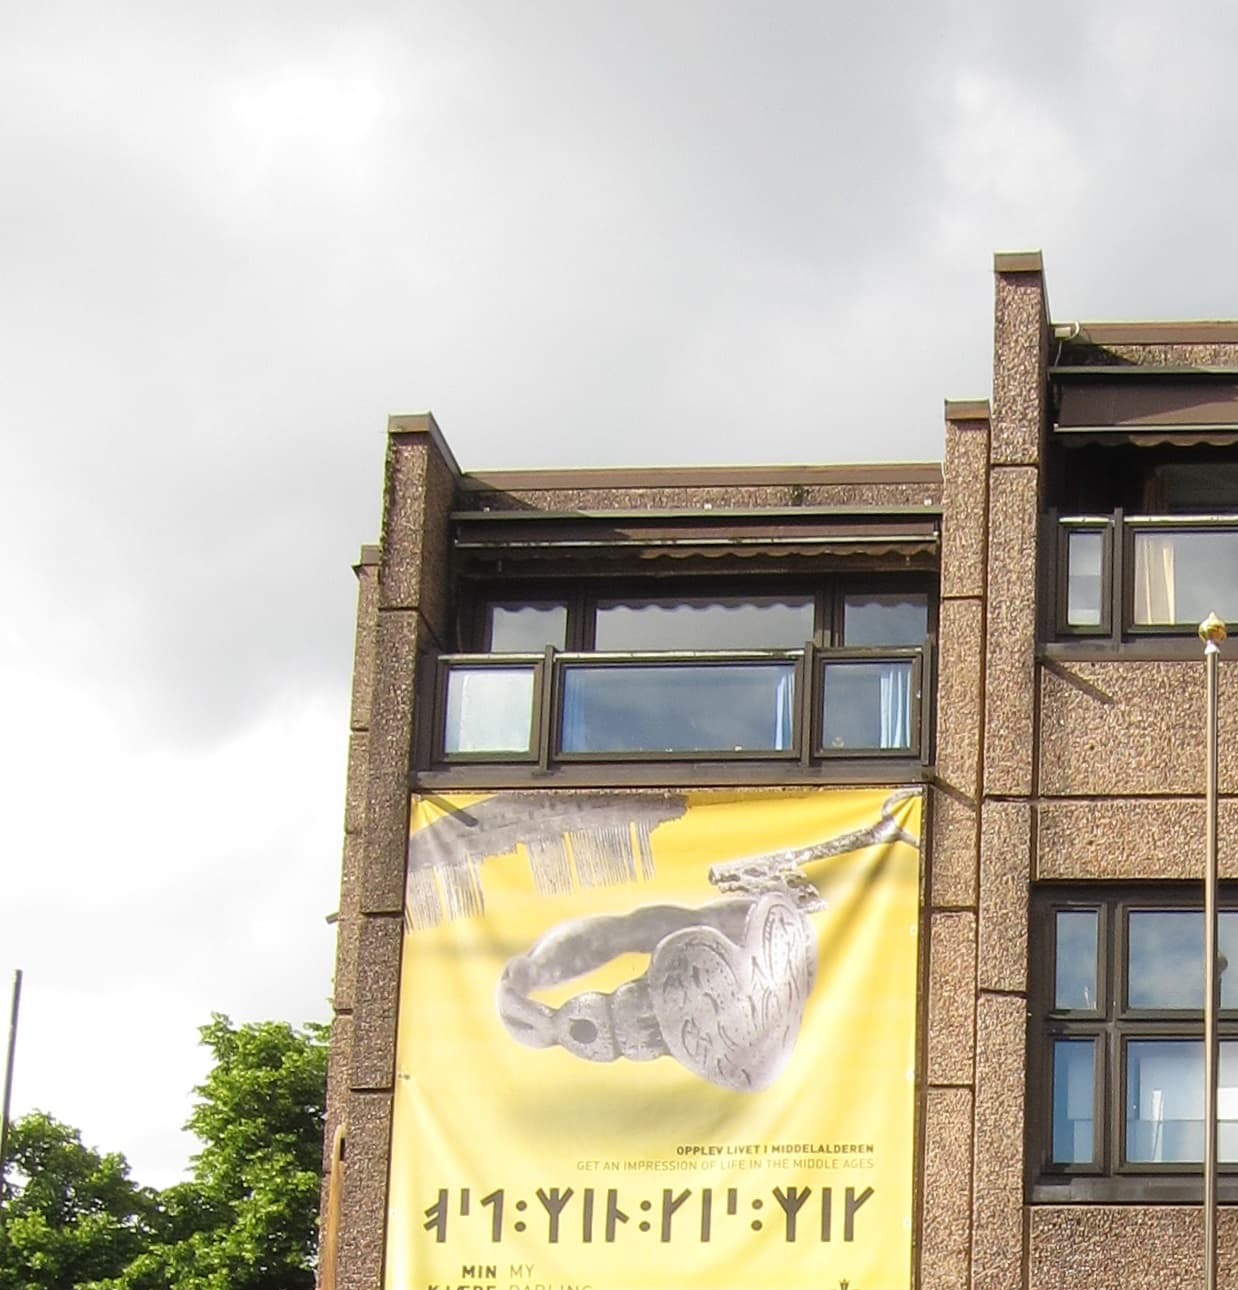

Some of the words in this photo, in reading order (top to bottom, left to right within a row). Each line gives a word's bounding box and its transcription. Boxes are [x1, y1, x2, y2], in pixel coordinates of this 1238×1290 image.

[677, 1145, 724, 1156] OPPLEV
[727, 1145, 761, 1155] LIVET
[764, 1145, 768, 1154] I
[772, 1144, 874, 1155] MIDDELALDEREN
[577, 1160, 600, 1171] GET
[603, 1160, 620, 1171] AN
[624, 1160, 697, 1171] IMPRESSION
[701, 1160, 716, 1170] OF
[721, 1160, 746, 1170] LIFE
[750, 1159, 762, 1169] IN
[767, 1159, 789, 1169] THE
[793, 1159, 838, 1169] MIDDLE
[843, 1158, 874, 1169] AGES
[462, 1265, 497, 1279] MIN
[510, 1264, 535, 1279] MY
